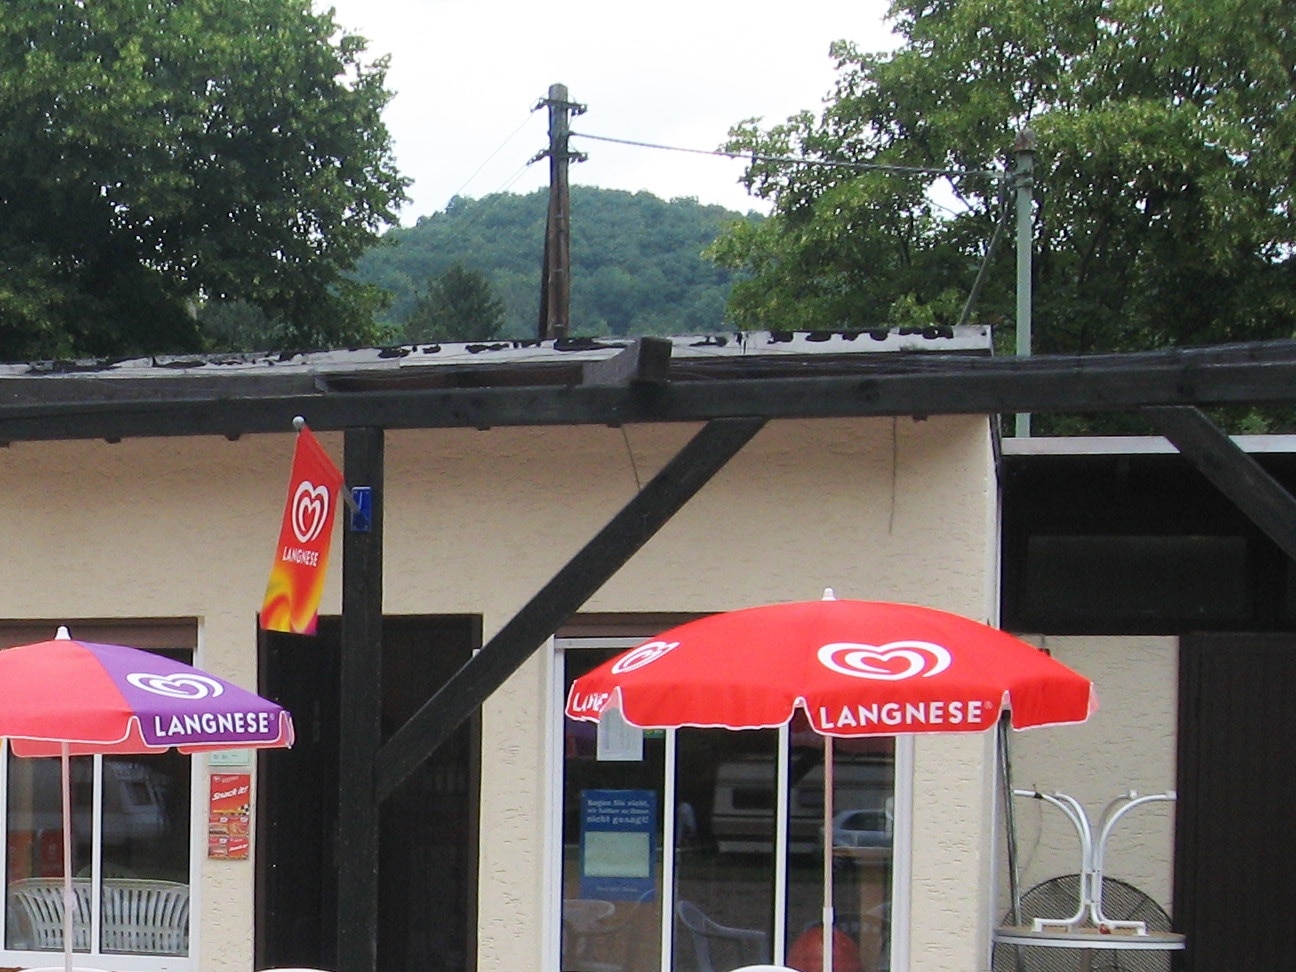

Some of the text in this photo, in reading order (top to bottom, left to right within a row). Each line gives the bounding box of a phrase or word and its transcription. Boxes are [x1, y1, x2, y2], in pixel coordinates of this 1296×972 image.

[282, 546, 319, 567] LANGNESE
[154, 712, 270, 737] LANGNESE
[819, 701, 982, 729] LANGNESE
